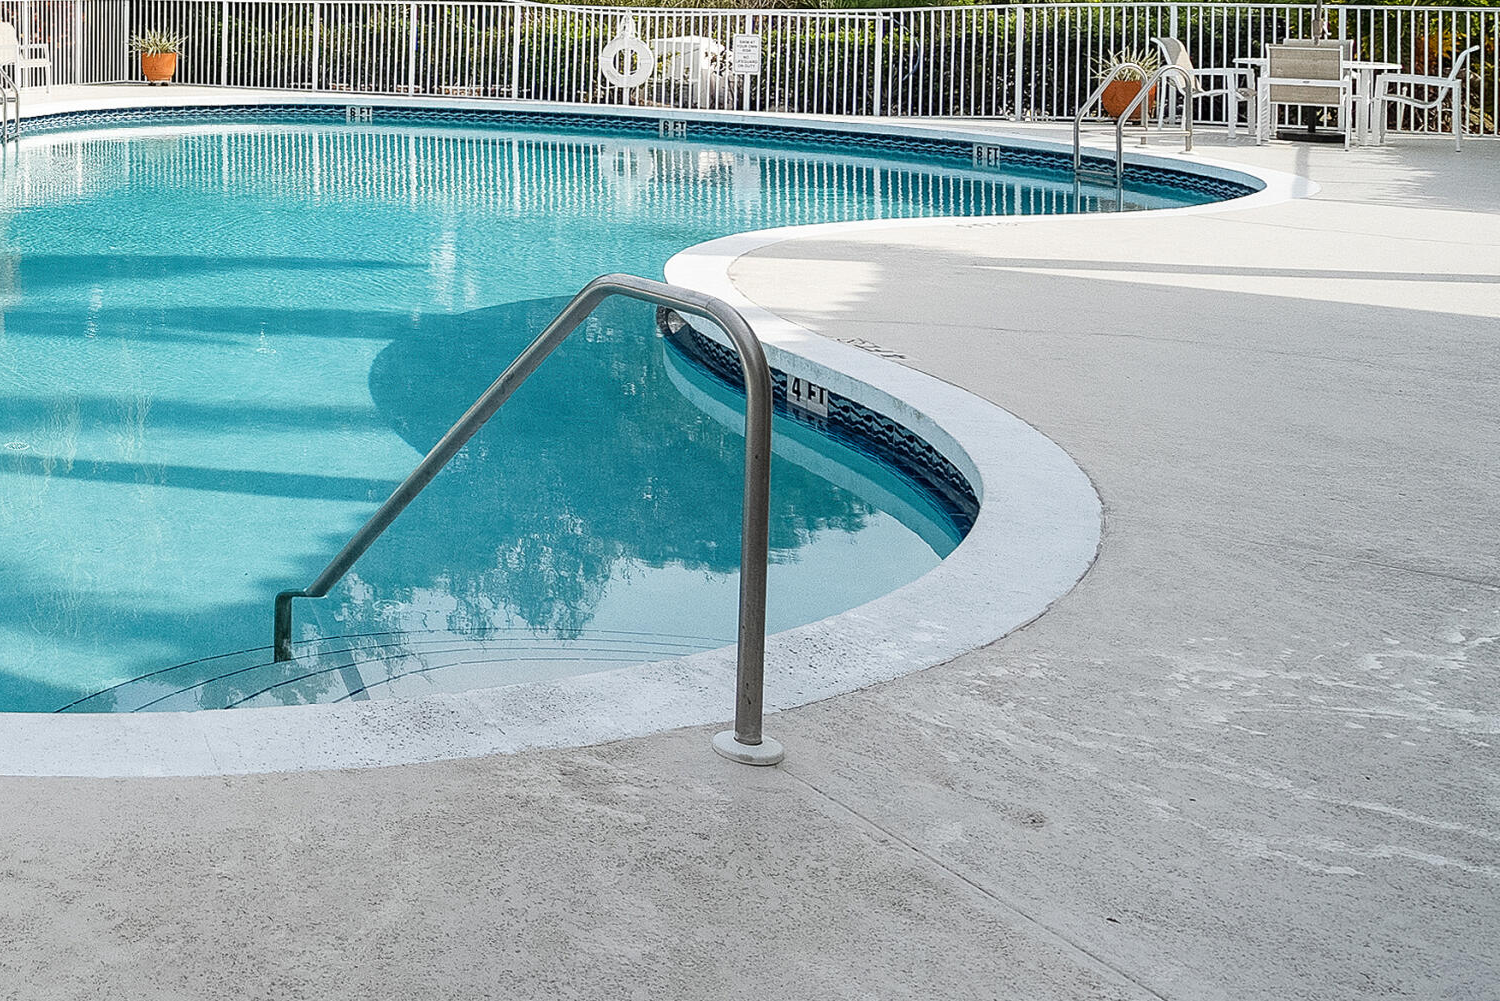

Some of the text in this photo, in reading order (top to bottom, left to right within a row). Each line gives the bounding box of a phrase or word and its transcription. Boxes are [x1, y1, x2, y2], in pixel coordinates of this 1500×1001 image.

[360, 107, 371, 115] FT
[663, 120, 685, 131] 6 FT
[976, 145, 999, 159] 6 FT
[791, 376, 828, 405] 4 FT
